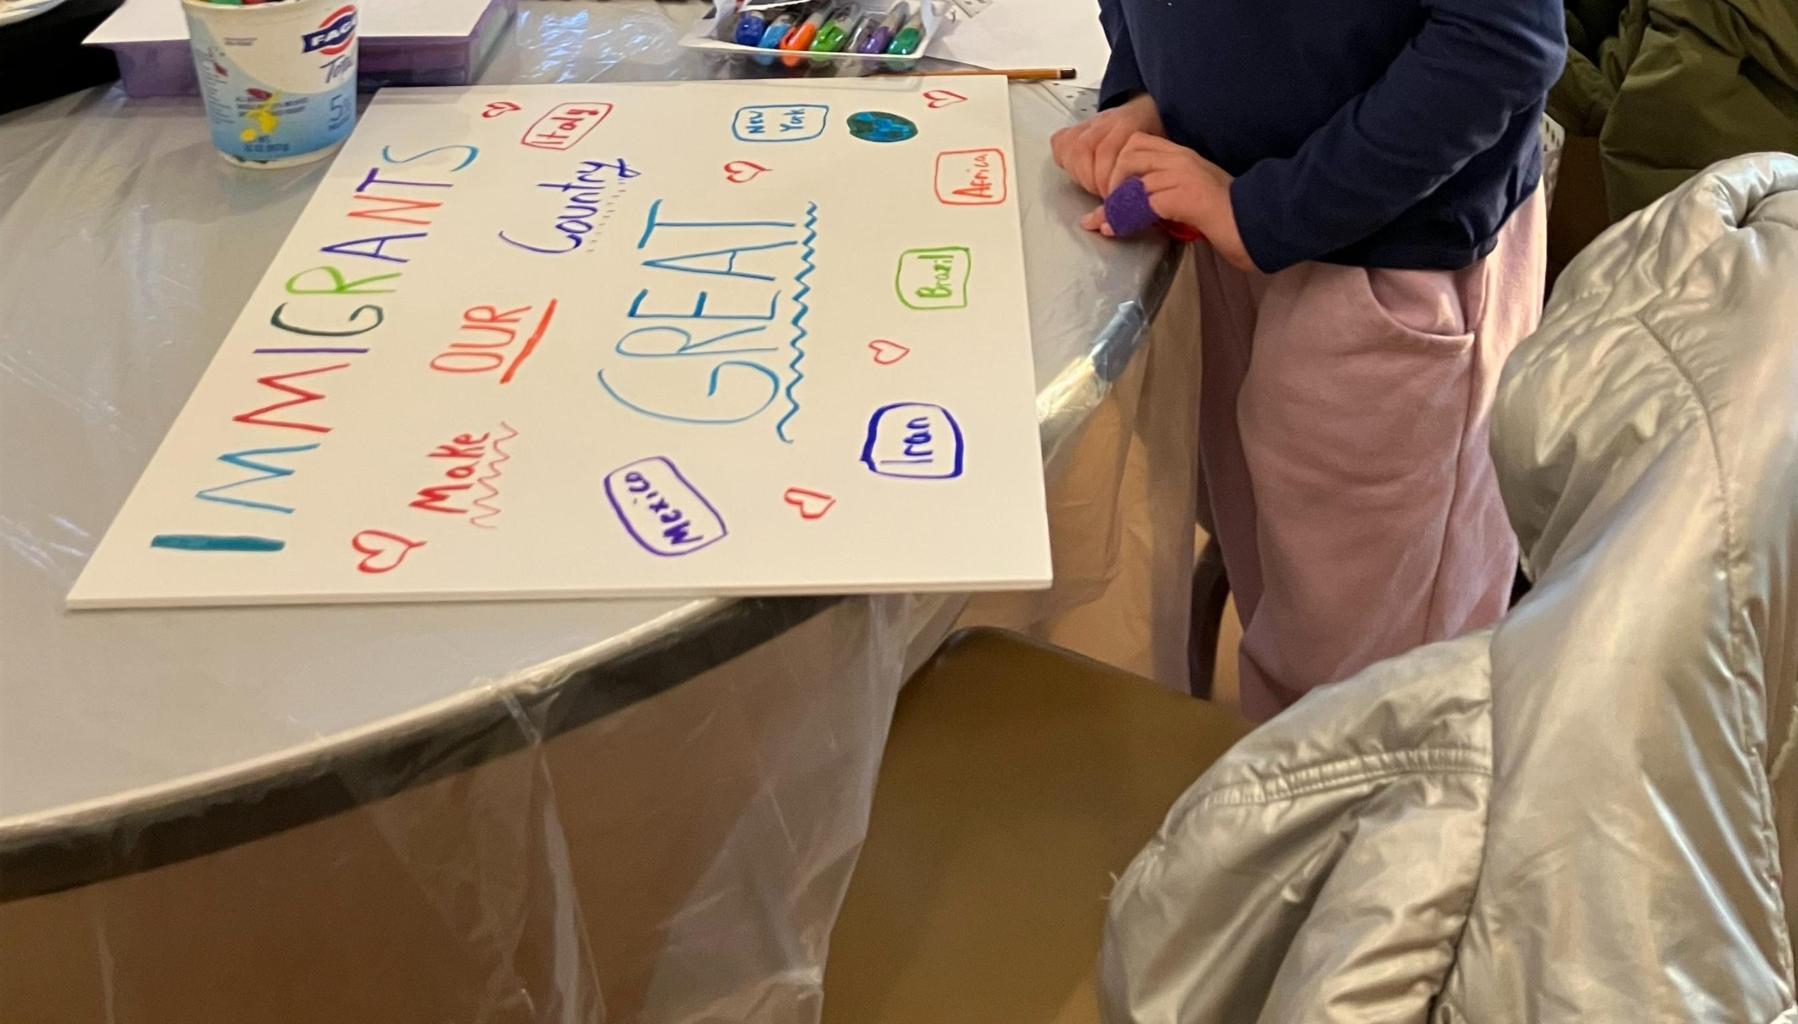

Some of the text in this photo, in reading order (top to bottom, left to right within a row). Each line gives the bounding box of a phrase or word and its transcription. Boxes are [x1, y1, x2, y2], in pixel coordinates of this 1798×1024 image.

[530, 108, 600, 145] Italy
[745, 110, 766, 134] New
[779, 108, 806, 133] York
[951, 154, 993, 199] Africa
[915, 255, 954, 298] Brazil
[598, 198, 799, 425] GREAT
[150, 144, 480, 553] IMMIGRANTS
[408, 158, 642, 515] Make OUR Country
[880, 416, 934, 465] Iran
[625, 471, 704, 545] Mexico
